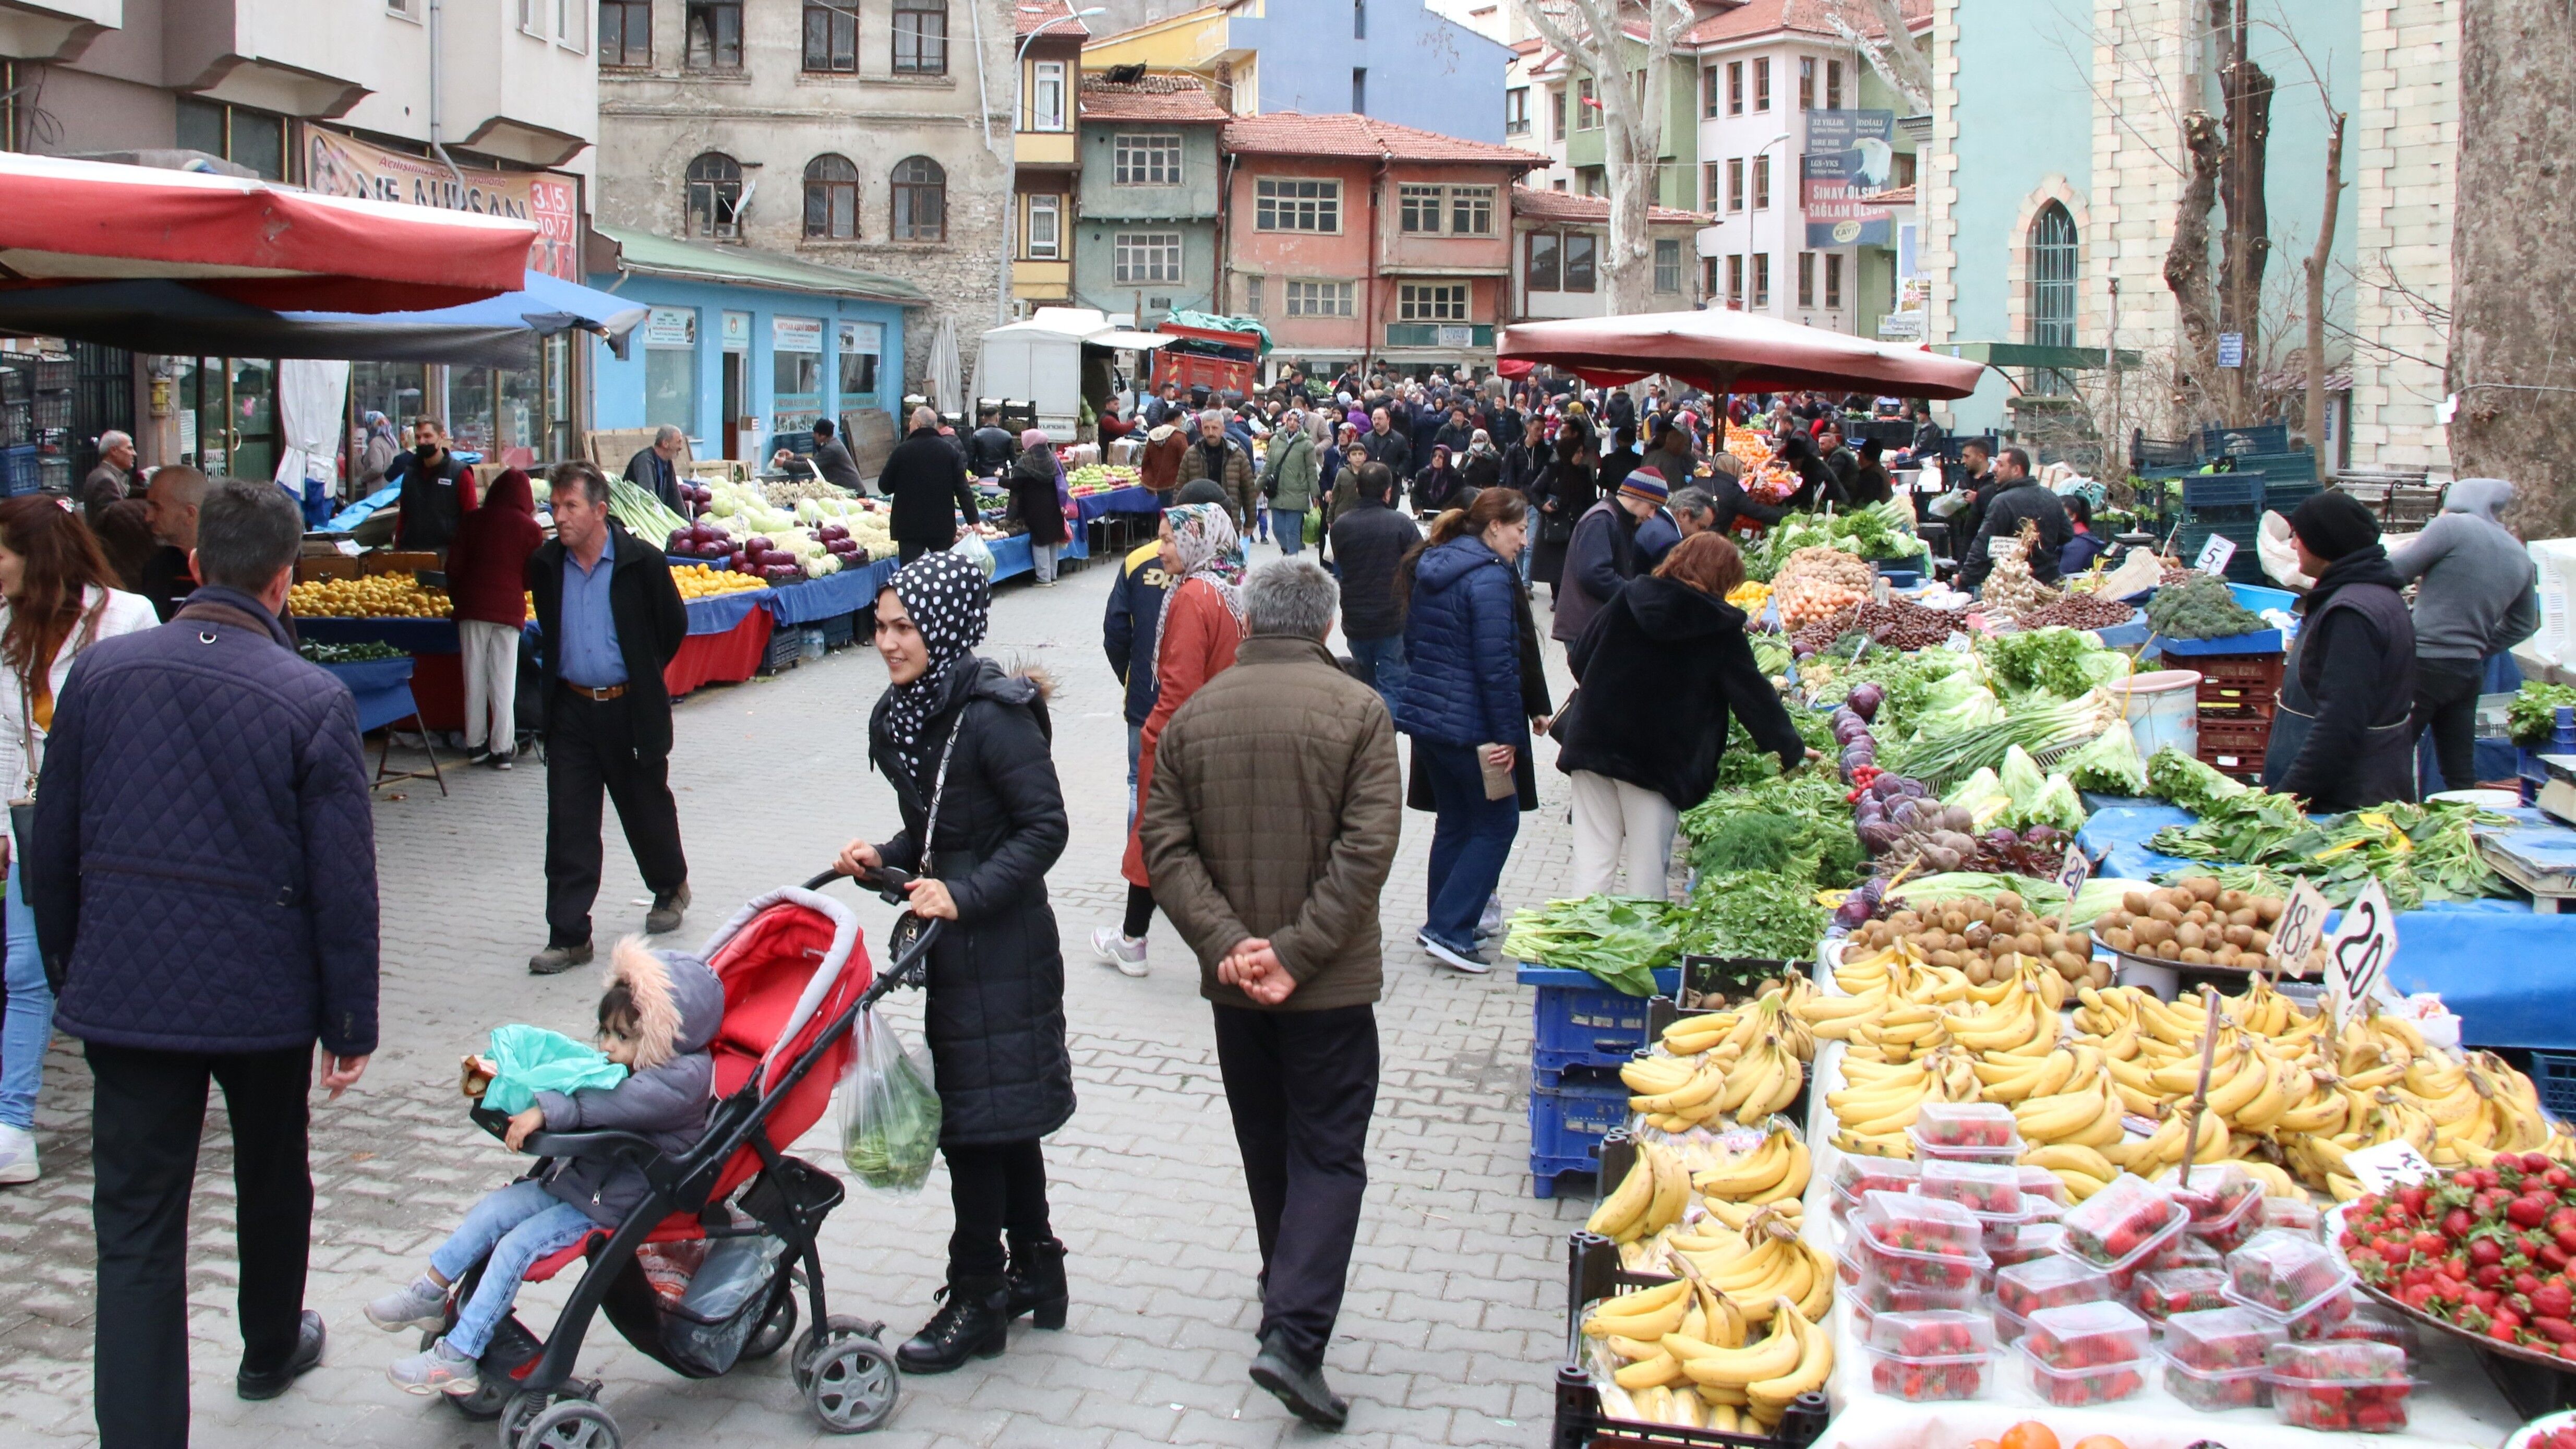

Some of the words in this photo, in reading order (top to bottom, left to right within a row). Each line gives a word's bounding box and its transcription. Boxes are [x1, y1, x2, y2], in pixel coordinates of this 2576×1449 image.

[1813, 185, 1845, 200] SINAV
[1809, 202, 1850, 218] SAĞLAM
[2063, 856, 2086, 896] 20
[2335, 901, 2384, 1000] 20
